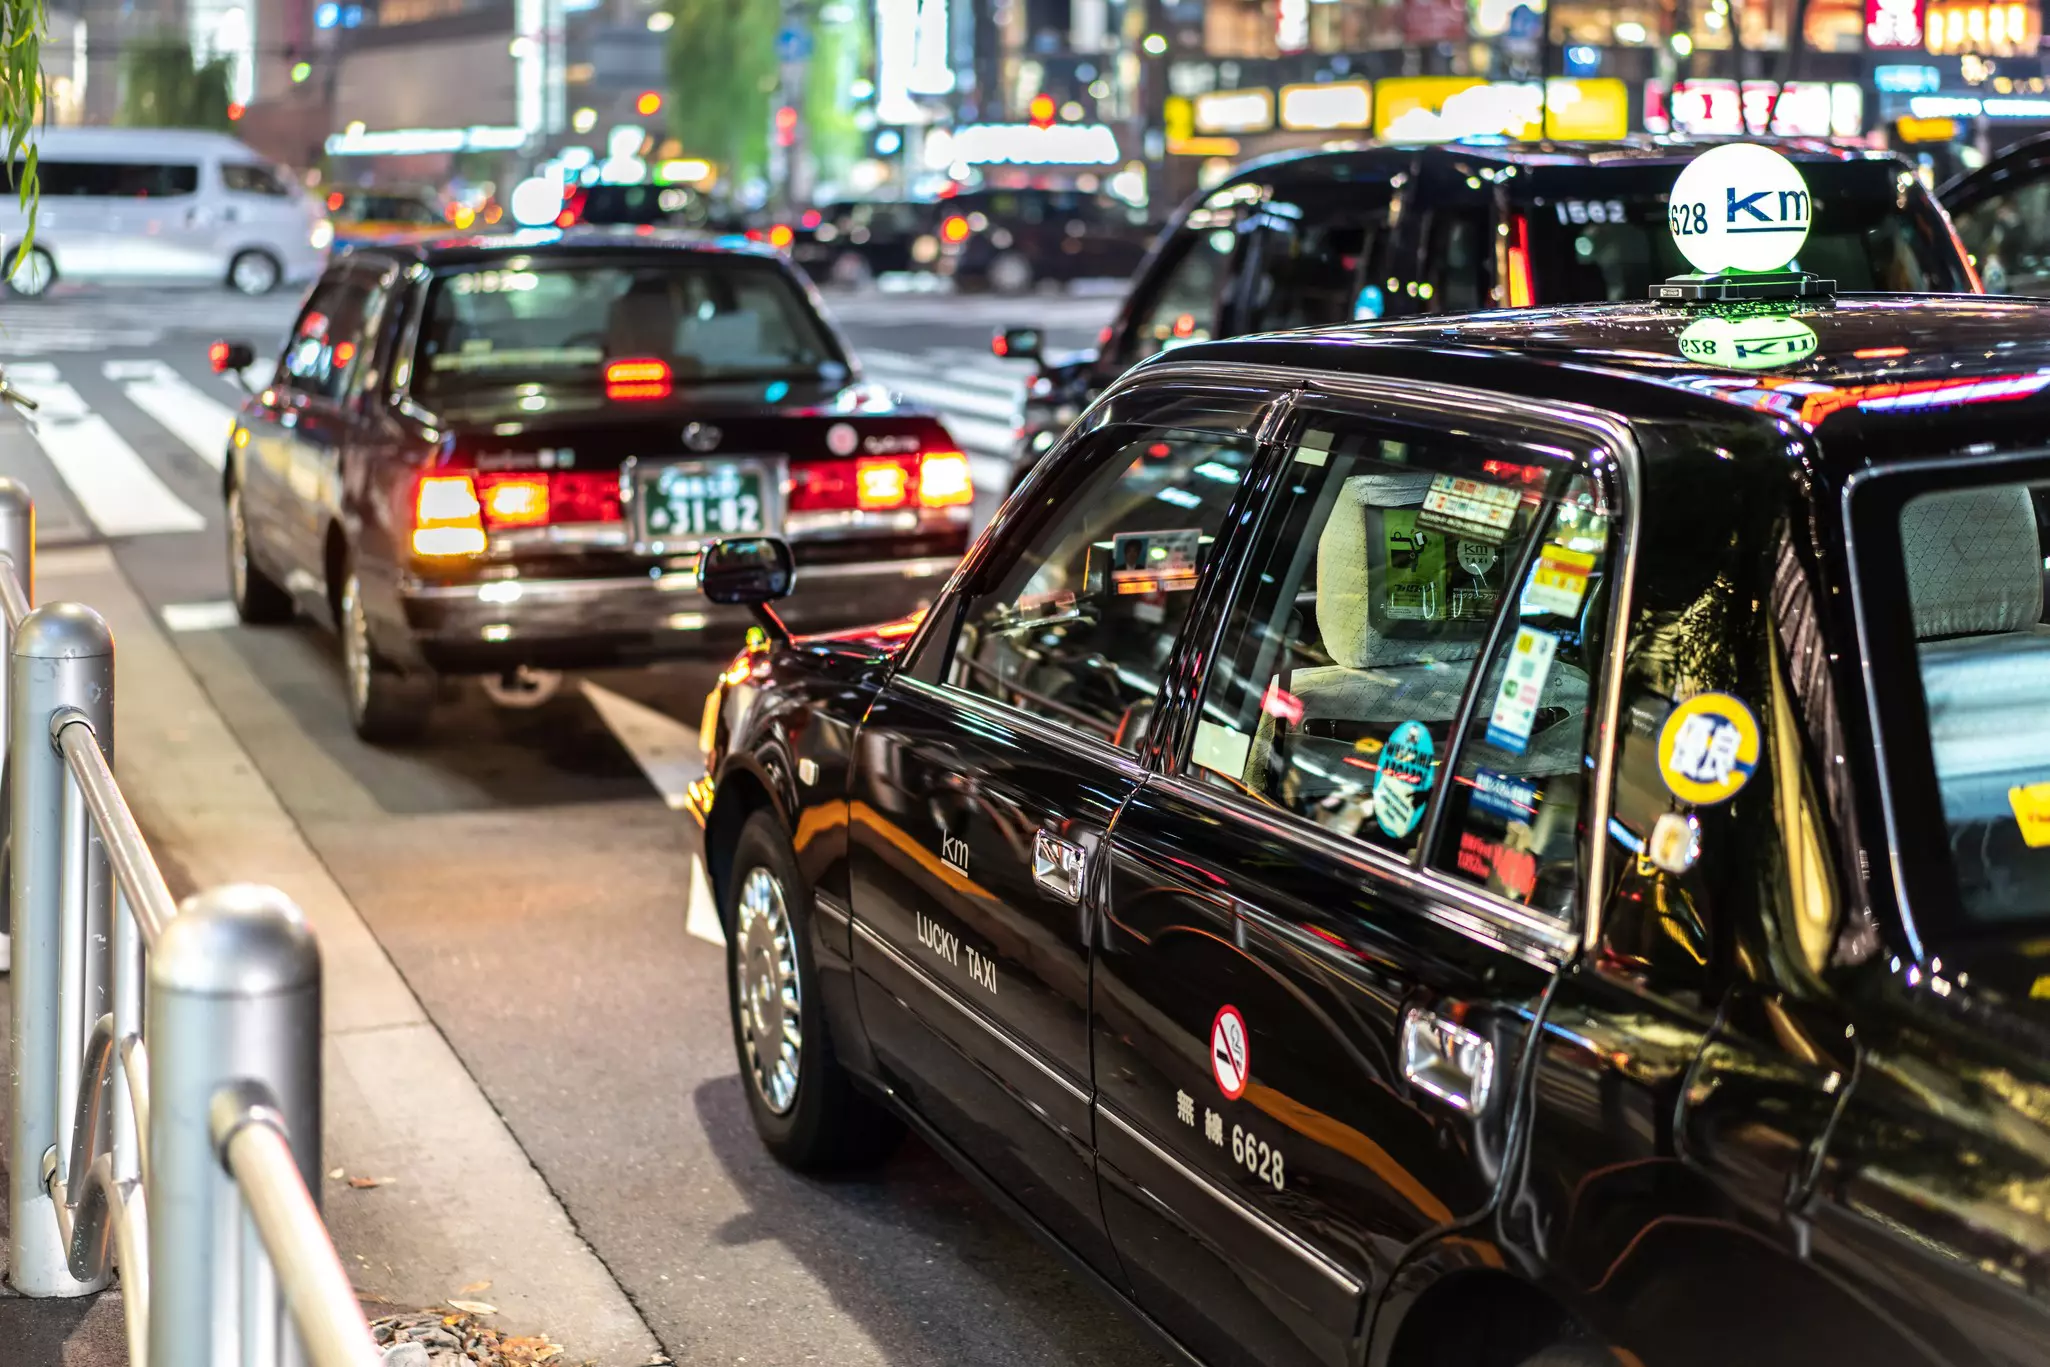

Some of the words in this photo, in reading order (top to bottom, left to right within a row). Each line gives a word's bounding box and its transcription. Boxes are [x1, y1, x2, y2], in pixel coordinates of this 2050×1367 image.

[1669, 203, 1708, 236] 628
[916, 911, 960, 967] LUCKY
[966, 945, 998, 995] TAXI
[1232, 1124, 1286, 1192] 6628
